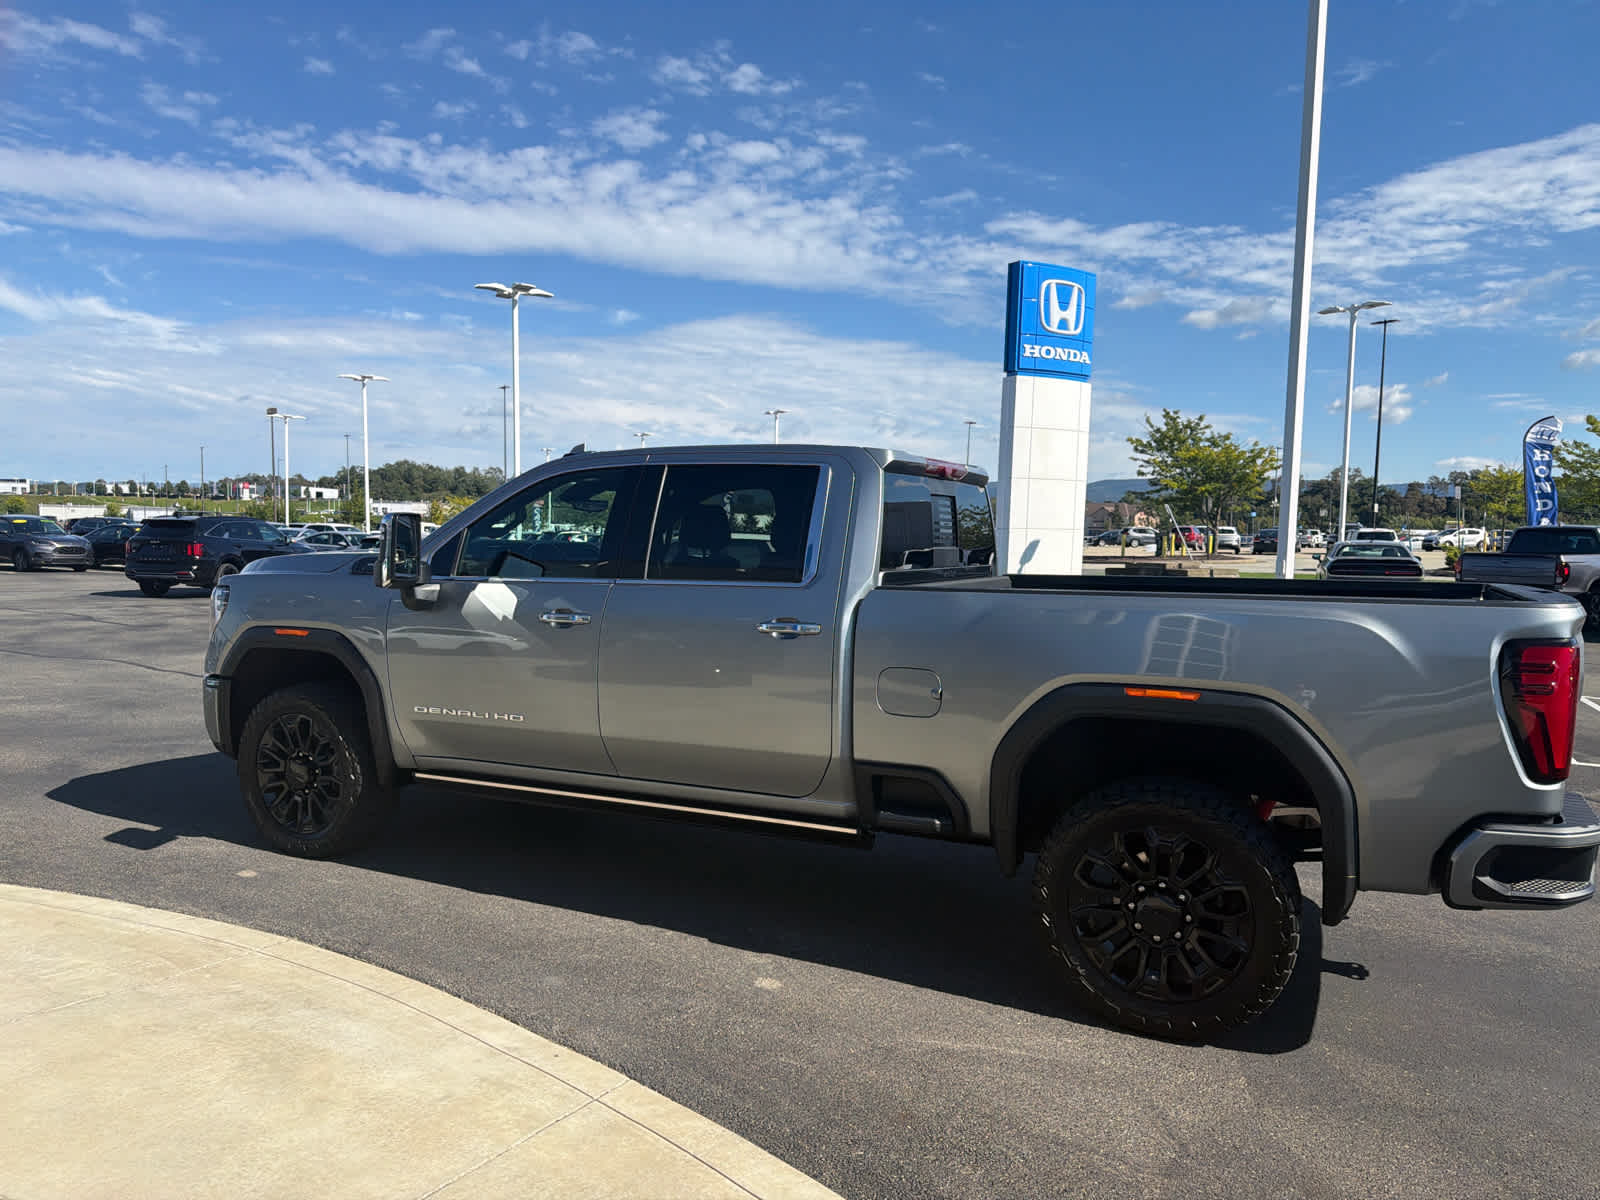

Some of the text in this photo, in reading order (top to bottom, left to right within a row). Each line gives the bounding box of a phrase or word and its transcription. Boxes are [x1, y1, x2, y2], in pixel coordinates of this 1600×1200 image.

[1023, 343, 1091, 365] HONDA
[414, 706, 524, 722] DENALI HD
